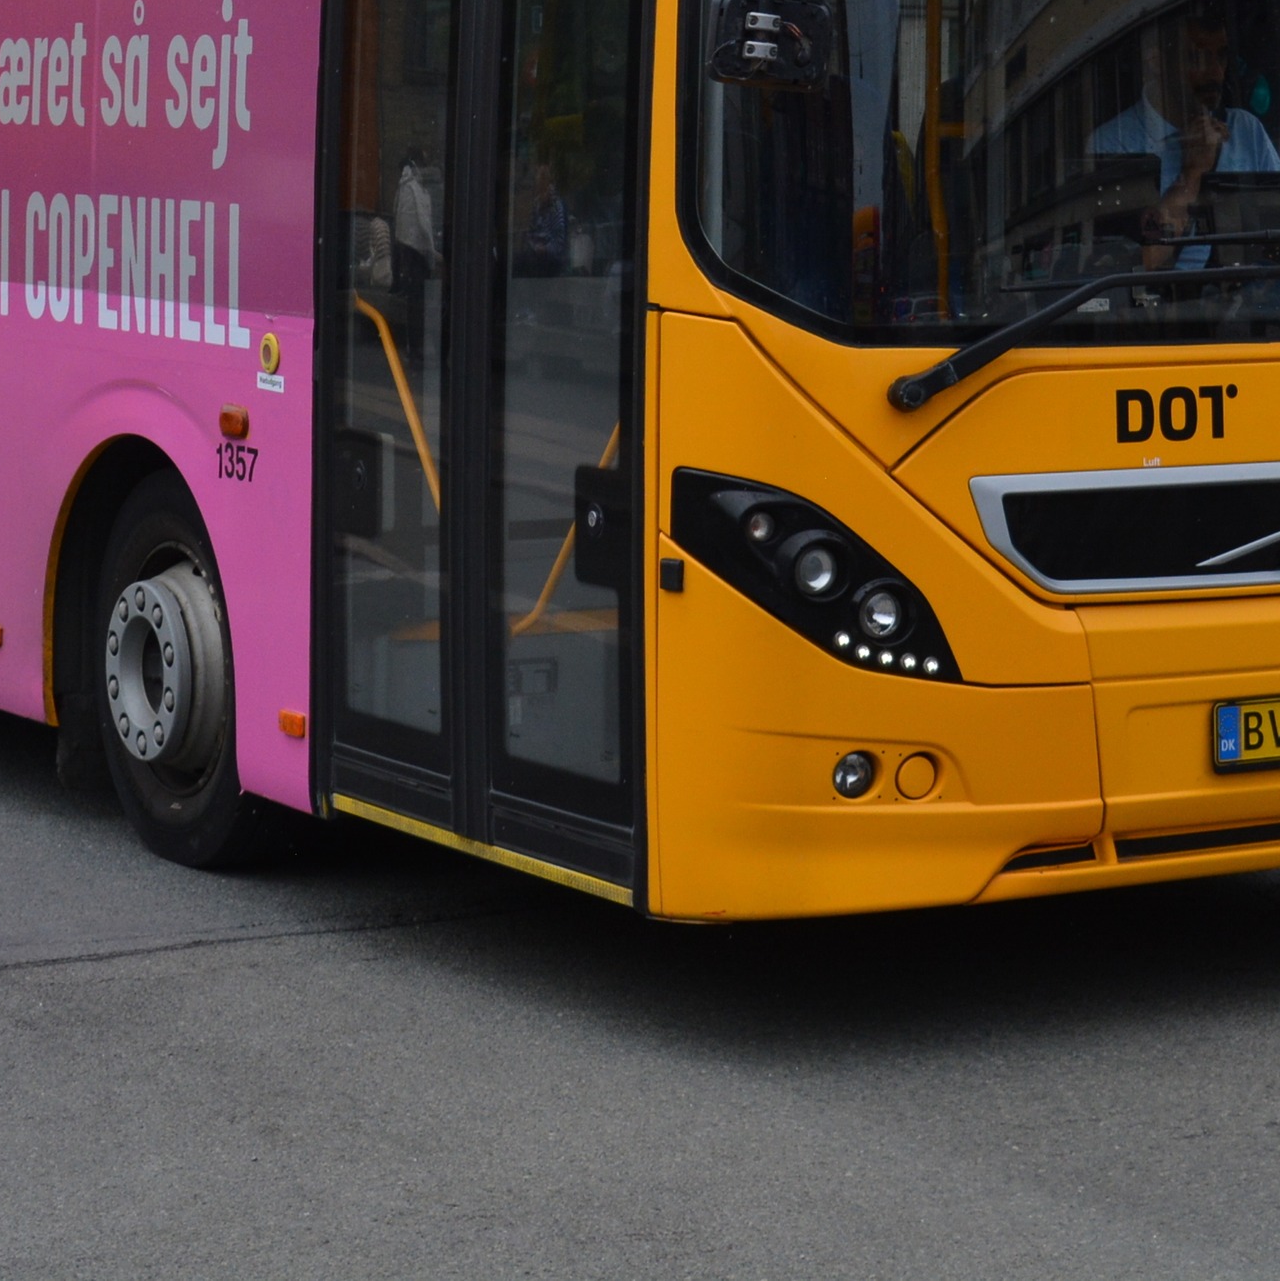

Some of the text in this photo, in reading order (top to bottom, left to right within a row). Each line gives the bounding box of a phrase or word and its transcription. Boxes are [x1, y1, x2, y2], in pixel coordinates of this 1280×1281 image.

[101, 0, 150, 128] så
[25, 190, 250, 349] COPENHELL
[1115, 383, 1238, 443] DOT
[216, 441, 259, 483] 1357
[1143, 456, 1161, 467] Luft
[1221, 738, 1236, 752] DK
